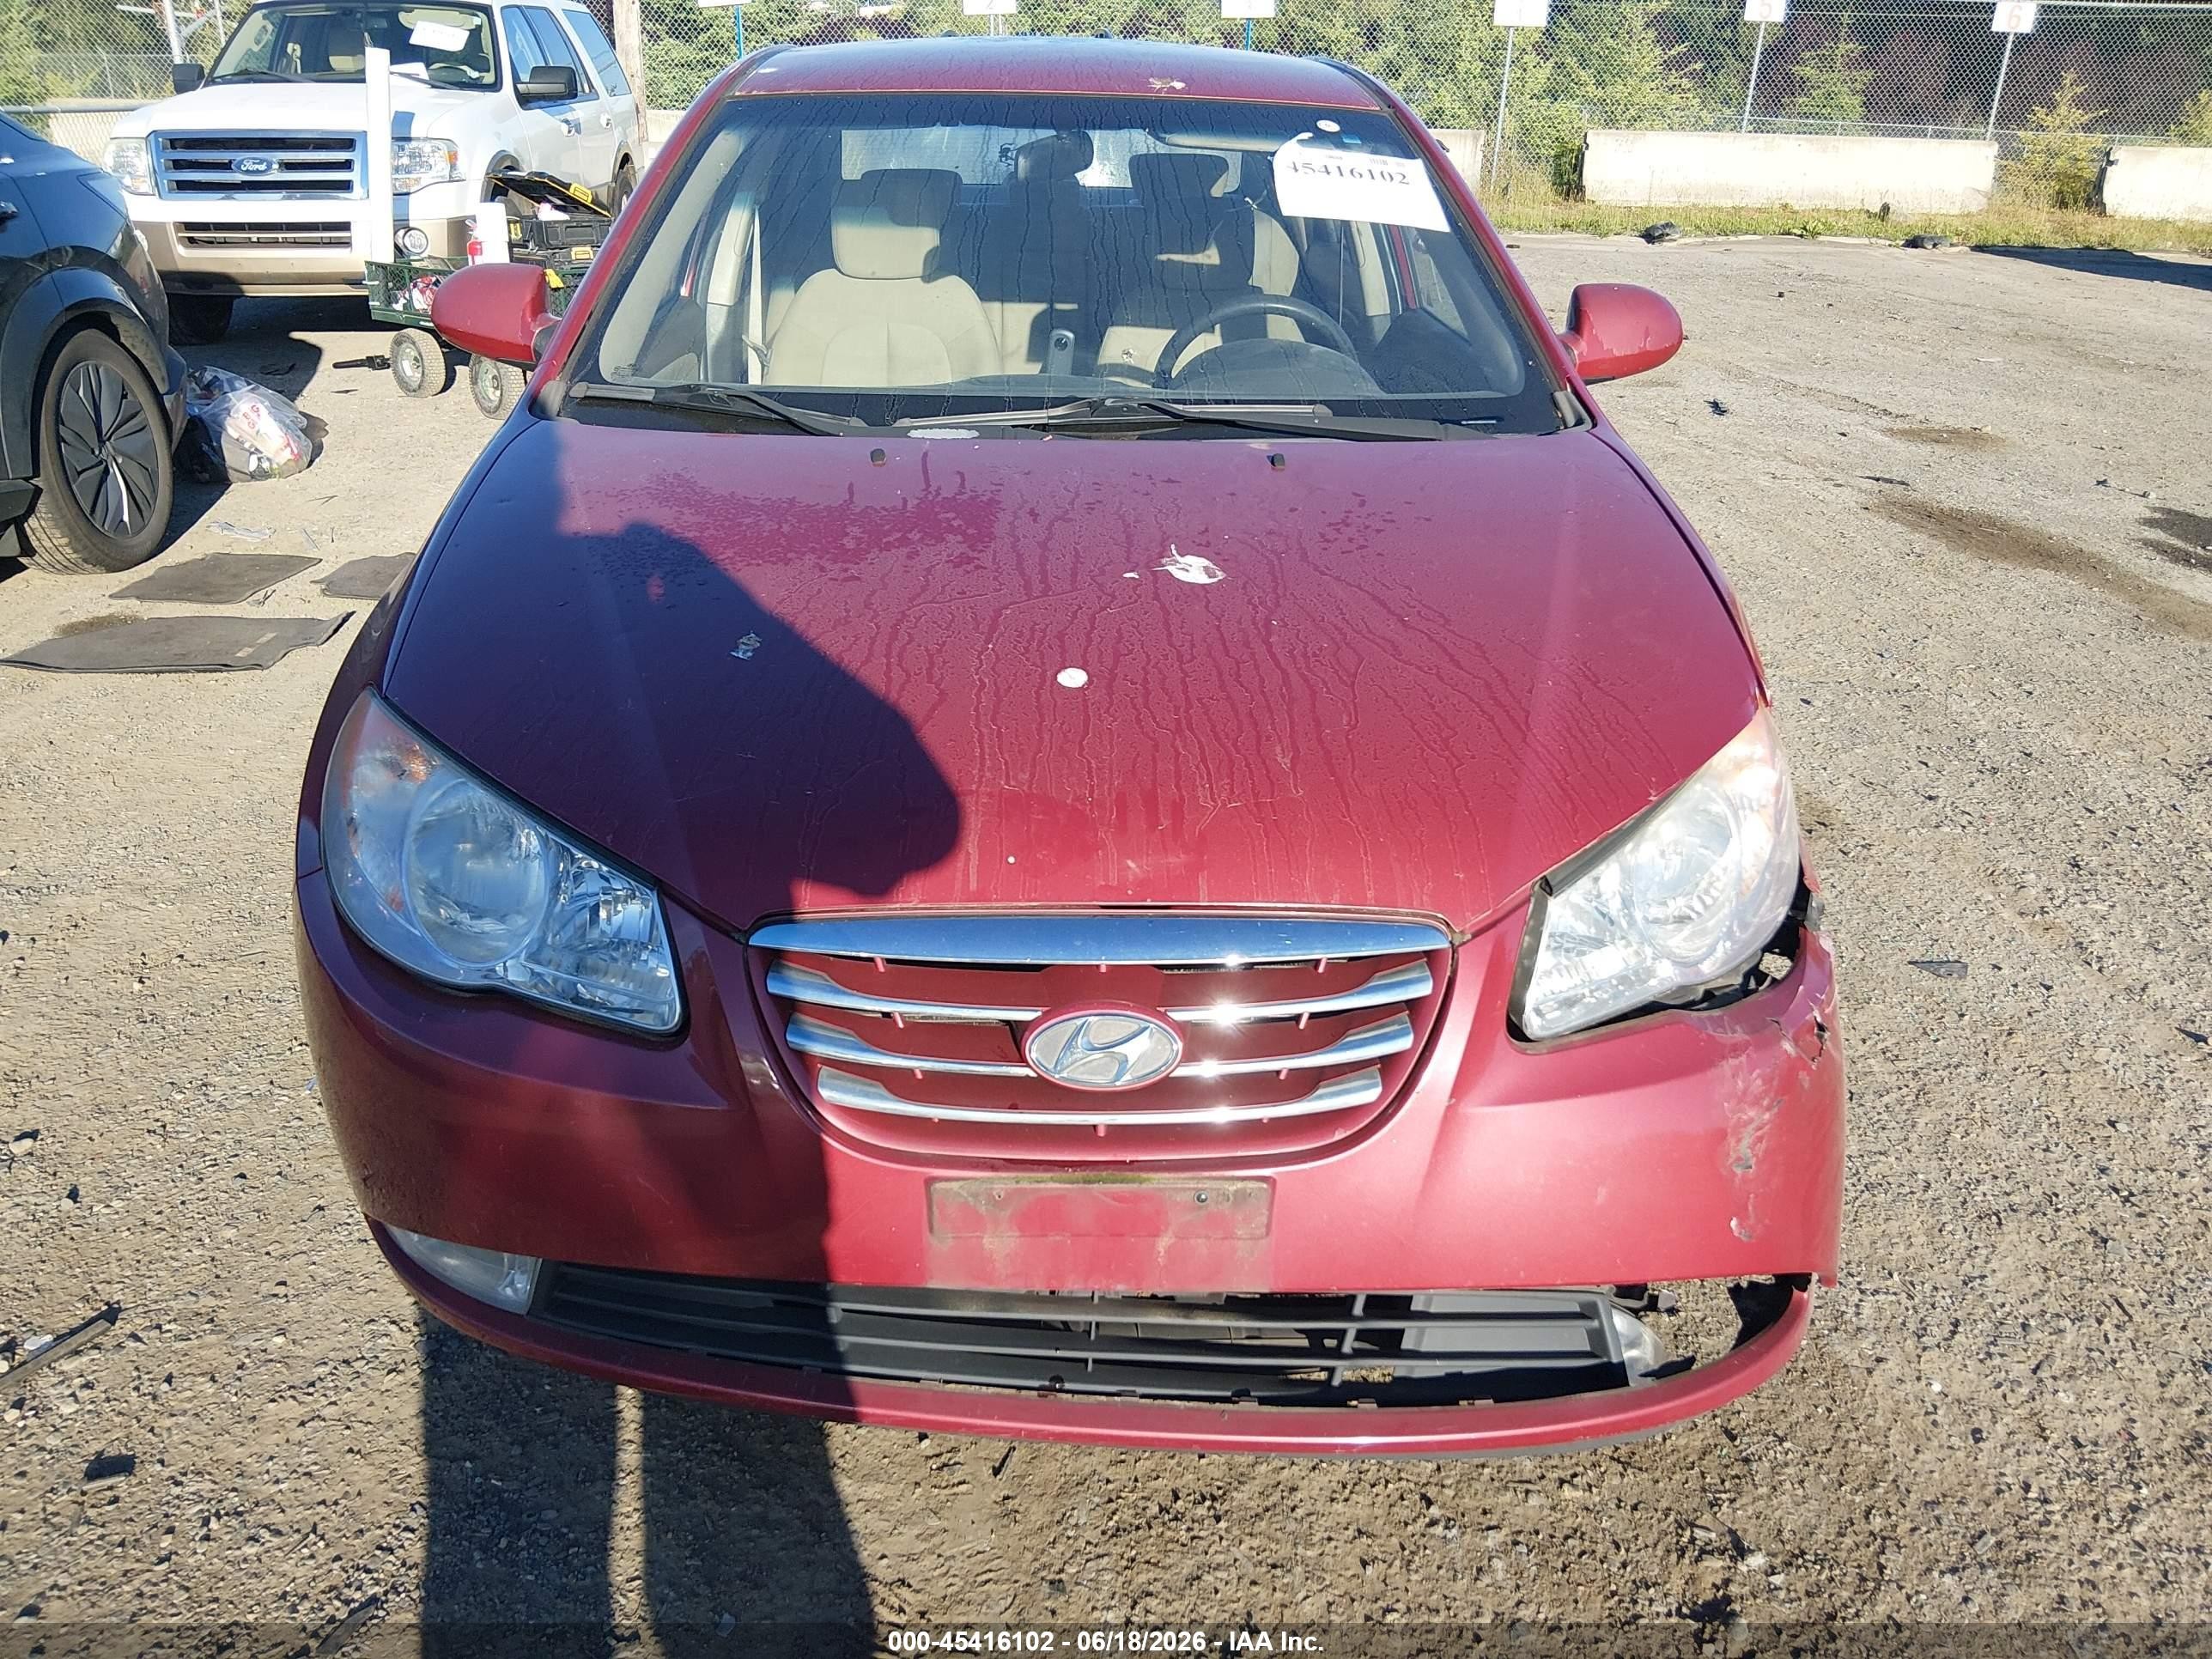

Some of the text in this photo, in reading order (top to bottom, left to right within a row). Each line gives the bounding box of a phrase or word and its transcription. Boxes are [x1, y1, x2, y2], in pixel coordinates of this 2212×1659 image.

[1759, 0, 1772, 19] 5
[2008, 4, 2022, 30] 6
[240, 159, 267, 171] Ford
[1285, 160, 1410, 185] 45416102
